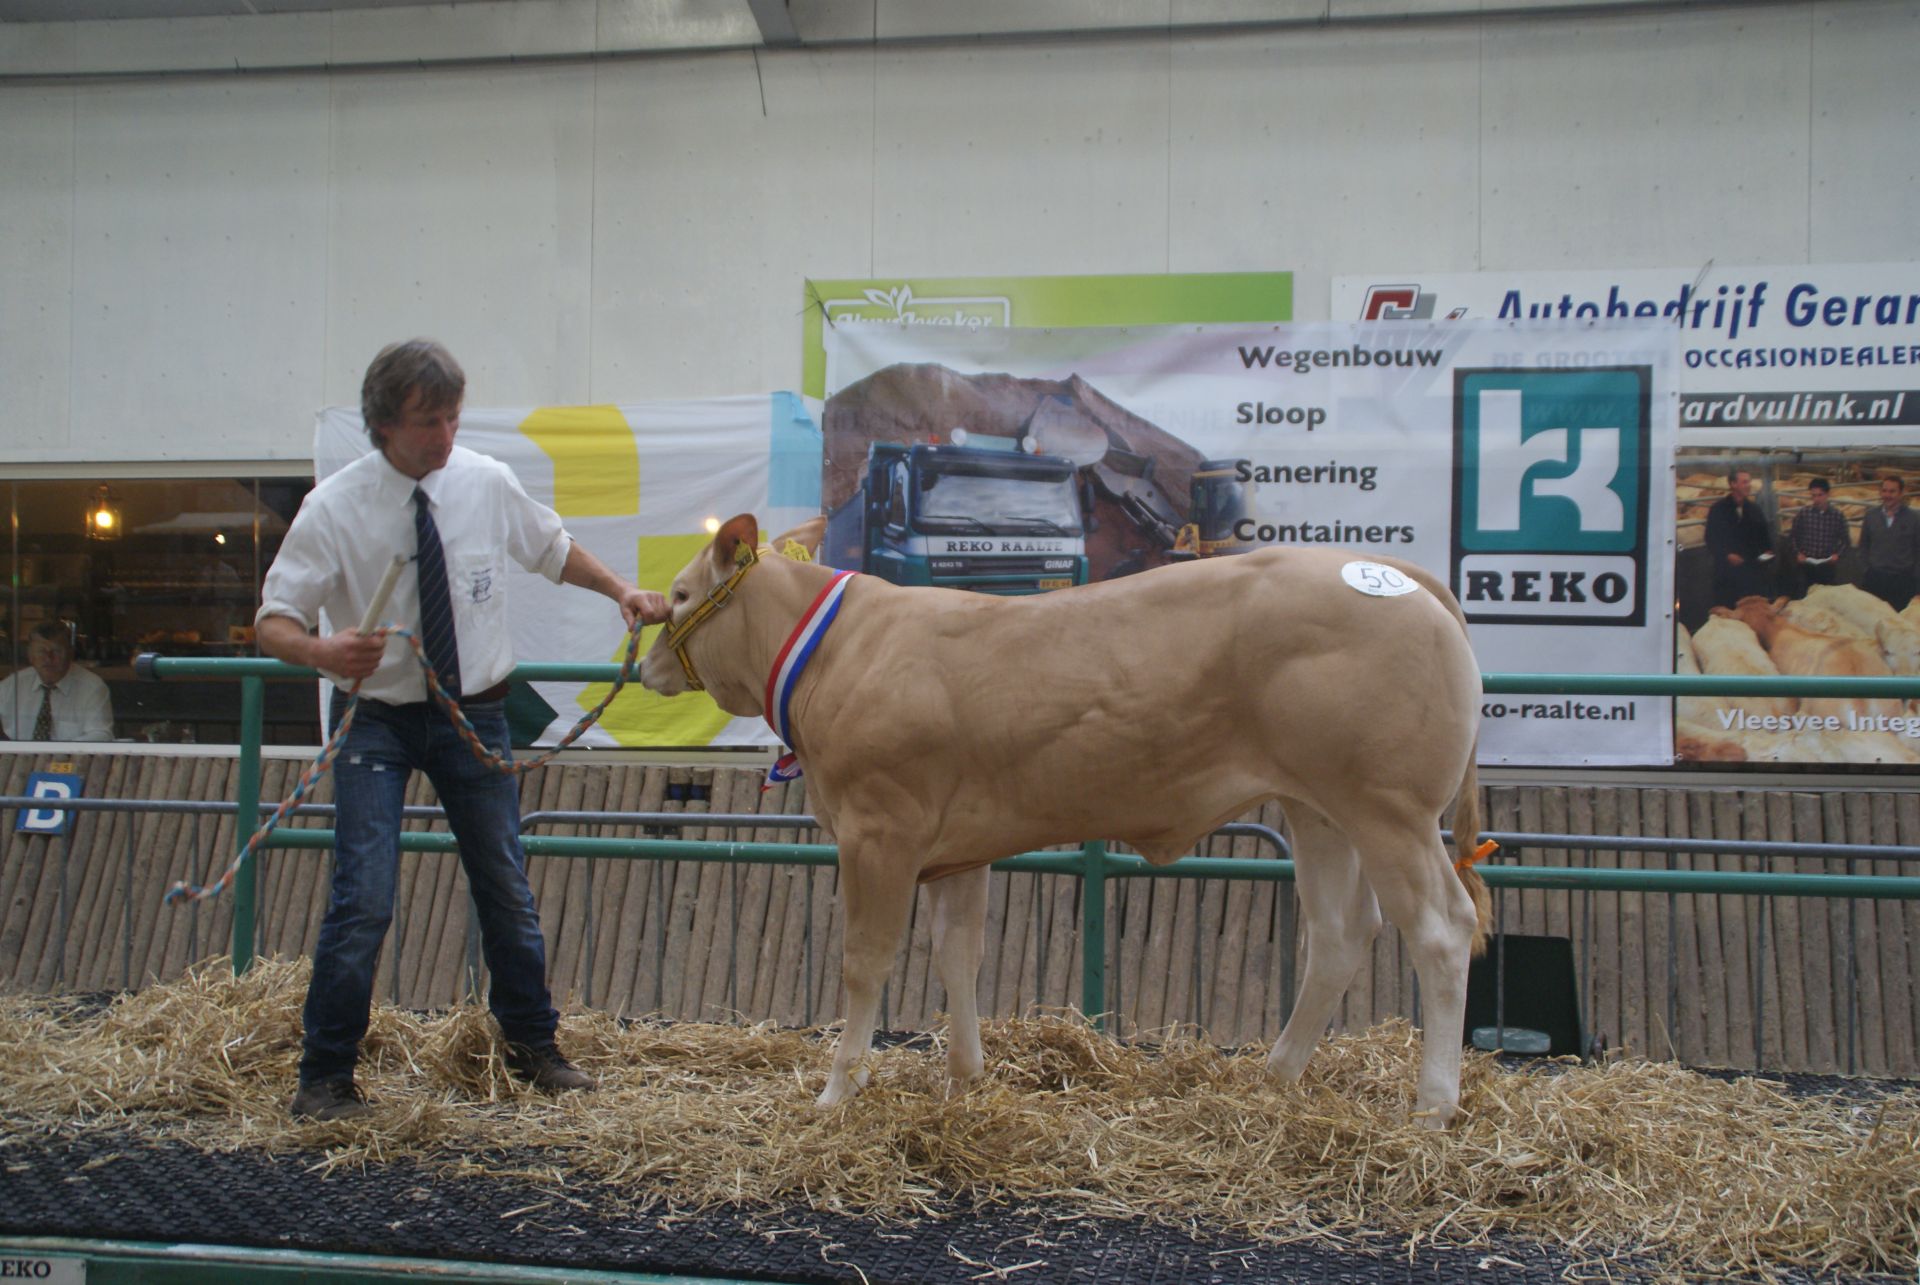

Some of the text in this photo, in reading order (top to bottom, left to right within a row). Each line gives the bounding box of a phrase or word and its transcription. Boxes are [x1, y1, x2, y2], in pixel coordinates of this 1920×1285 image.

[1238, 344, 1443, 374] Wegenbouw
[1236, 401, 1327, 432] Sloop
[1234, 459, 1378, 491] Sanering
[1233, 518, 1415, 544] Containers
[946, 541, 1063, 552] REKO RAALTE
[1044, 560, 1074, 569] GINAF
[1360, 567, 1404, 588] 50
[1466, 570, 1629, 604] REKO
[1717, 708, 1841, 731] Vleesvee
[25, 781, 71, 829] B
